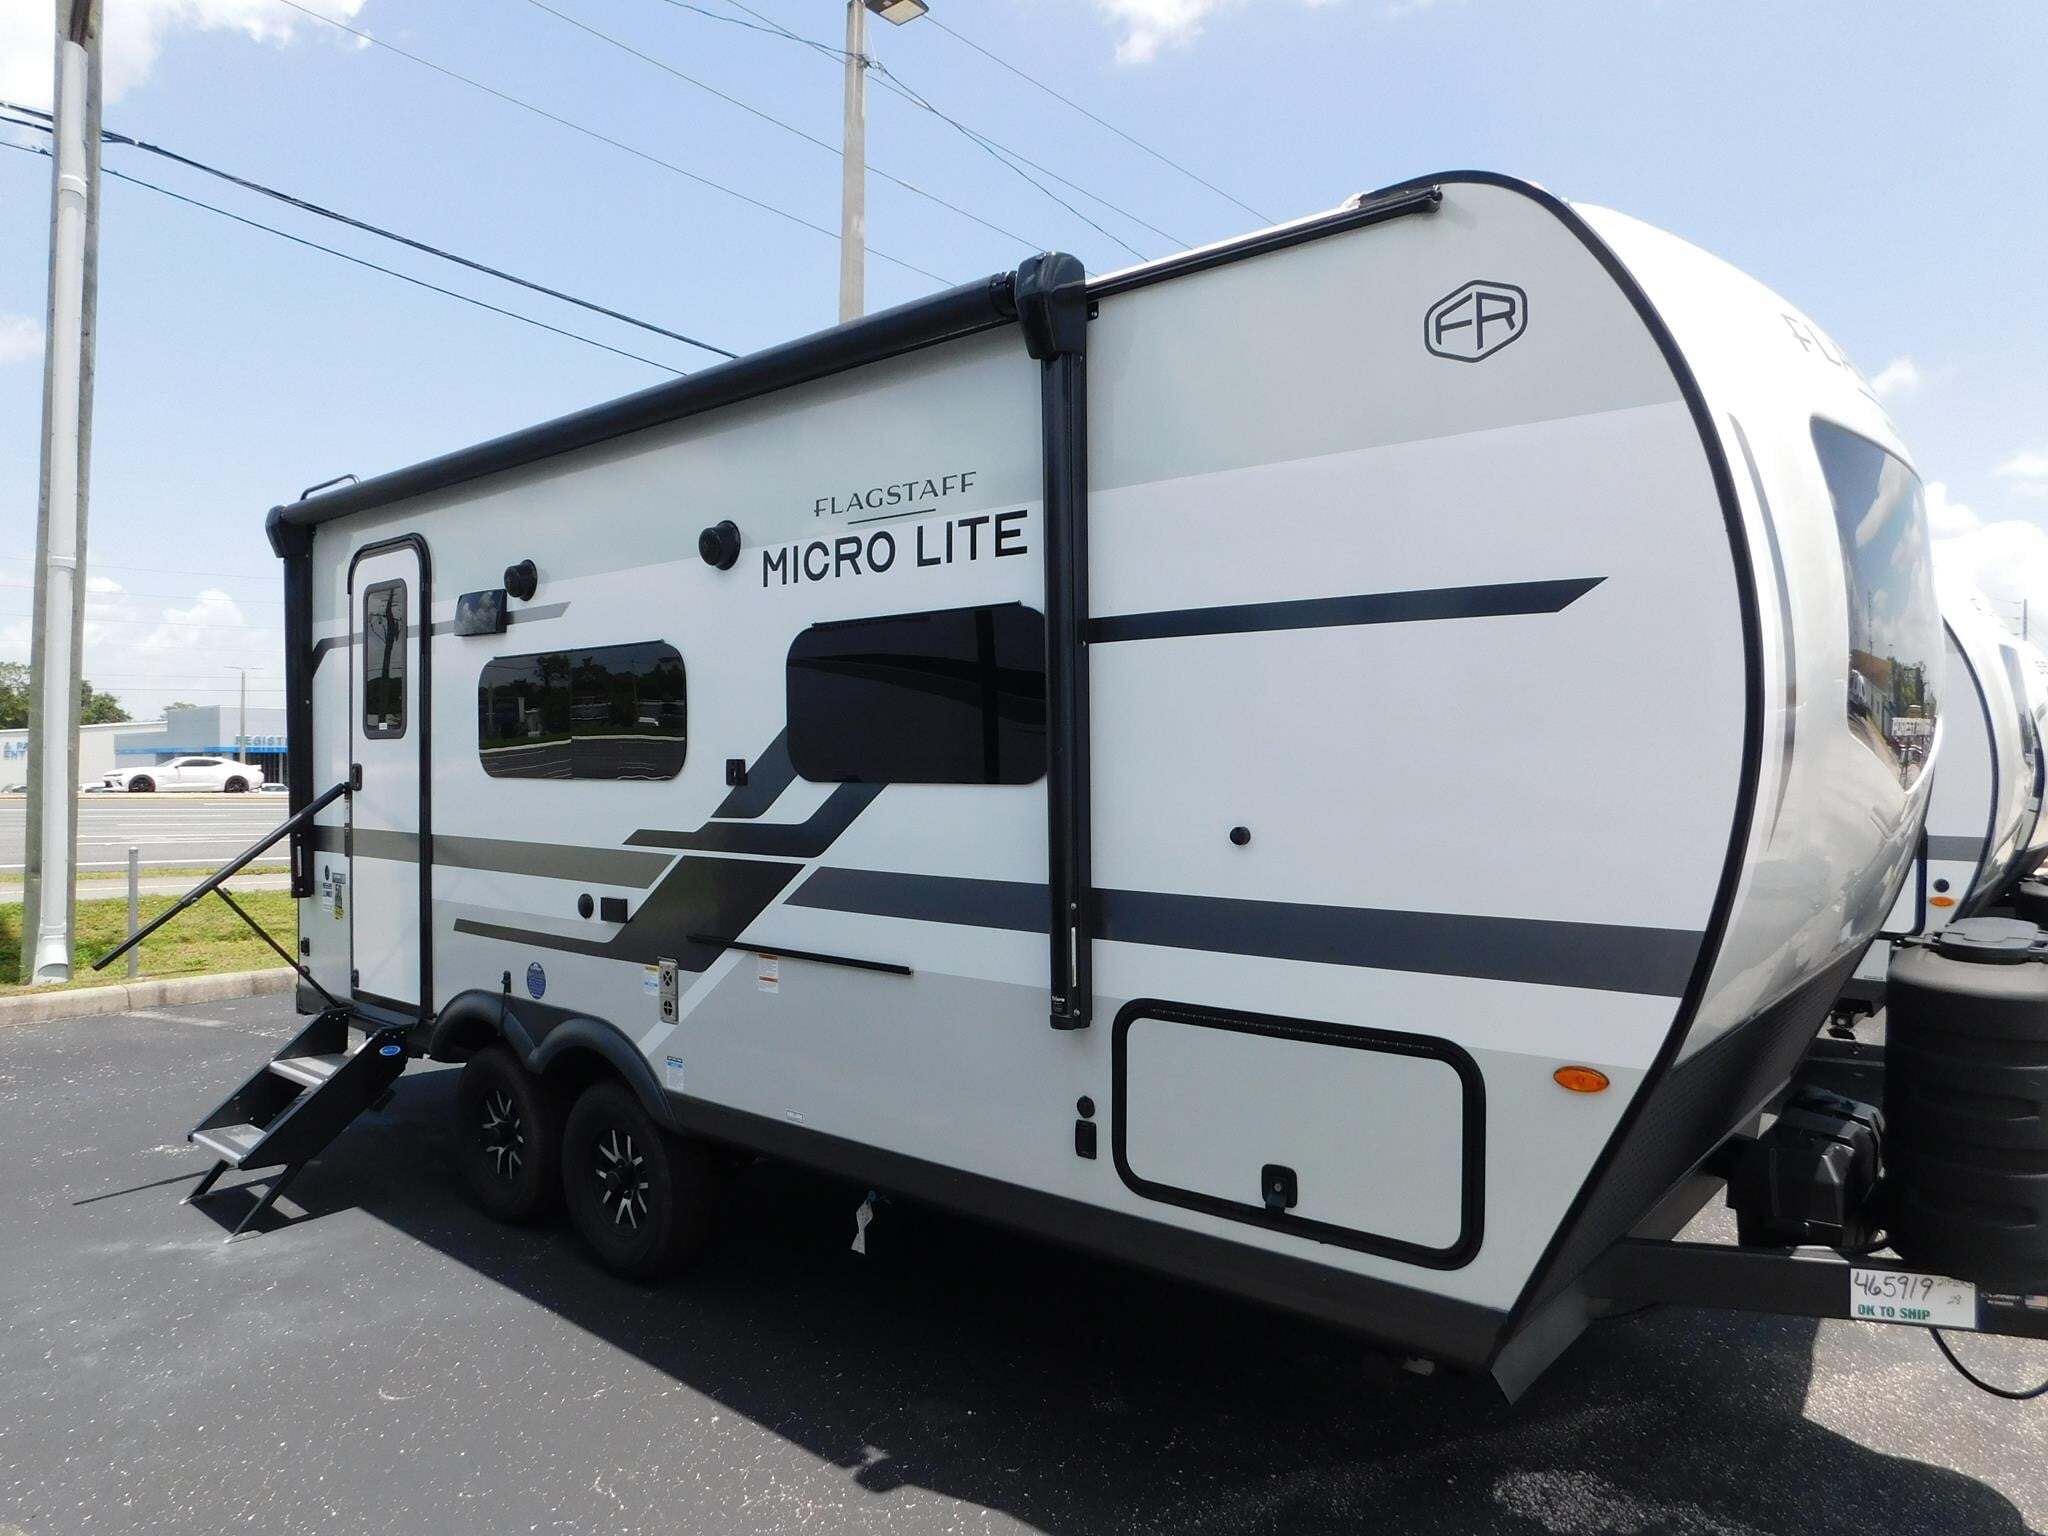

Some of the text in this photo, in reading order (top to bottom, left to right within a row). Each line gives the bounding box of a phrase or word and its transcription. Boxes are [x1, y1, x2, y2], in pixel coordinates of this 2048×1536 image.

[1435, 291, 1516, 351] FR
[814, 471, 977, 517] FLAGSTAFF
[762, 509, 1028, 588] MICRO LITE
[1853, 1271, 1934, 1301] 465919
[1857, 1304, 1931, 1321] OK TO SHIP
